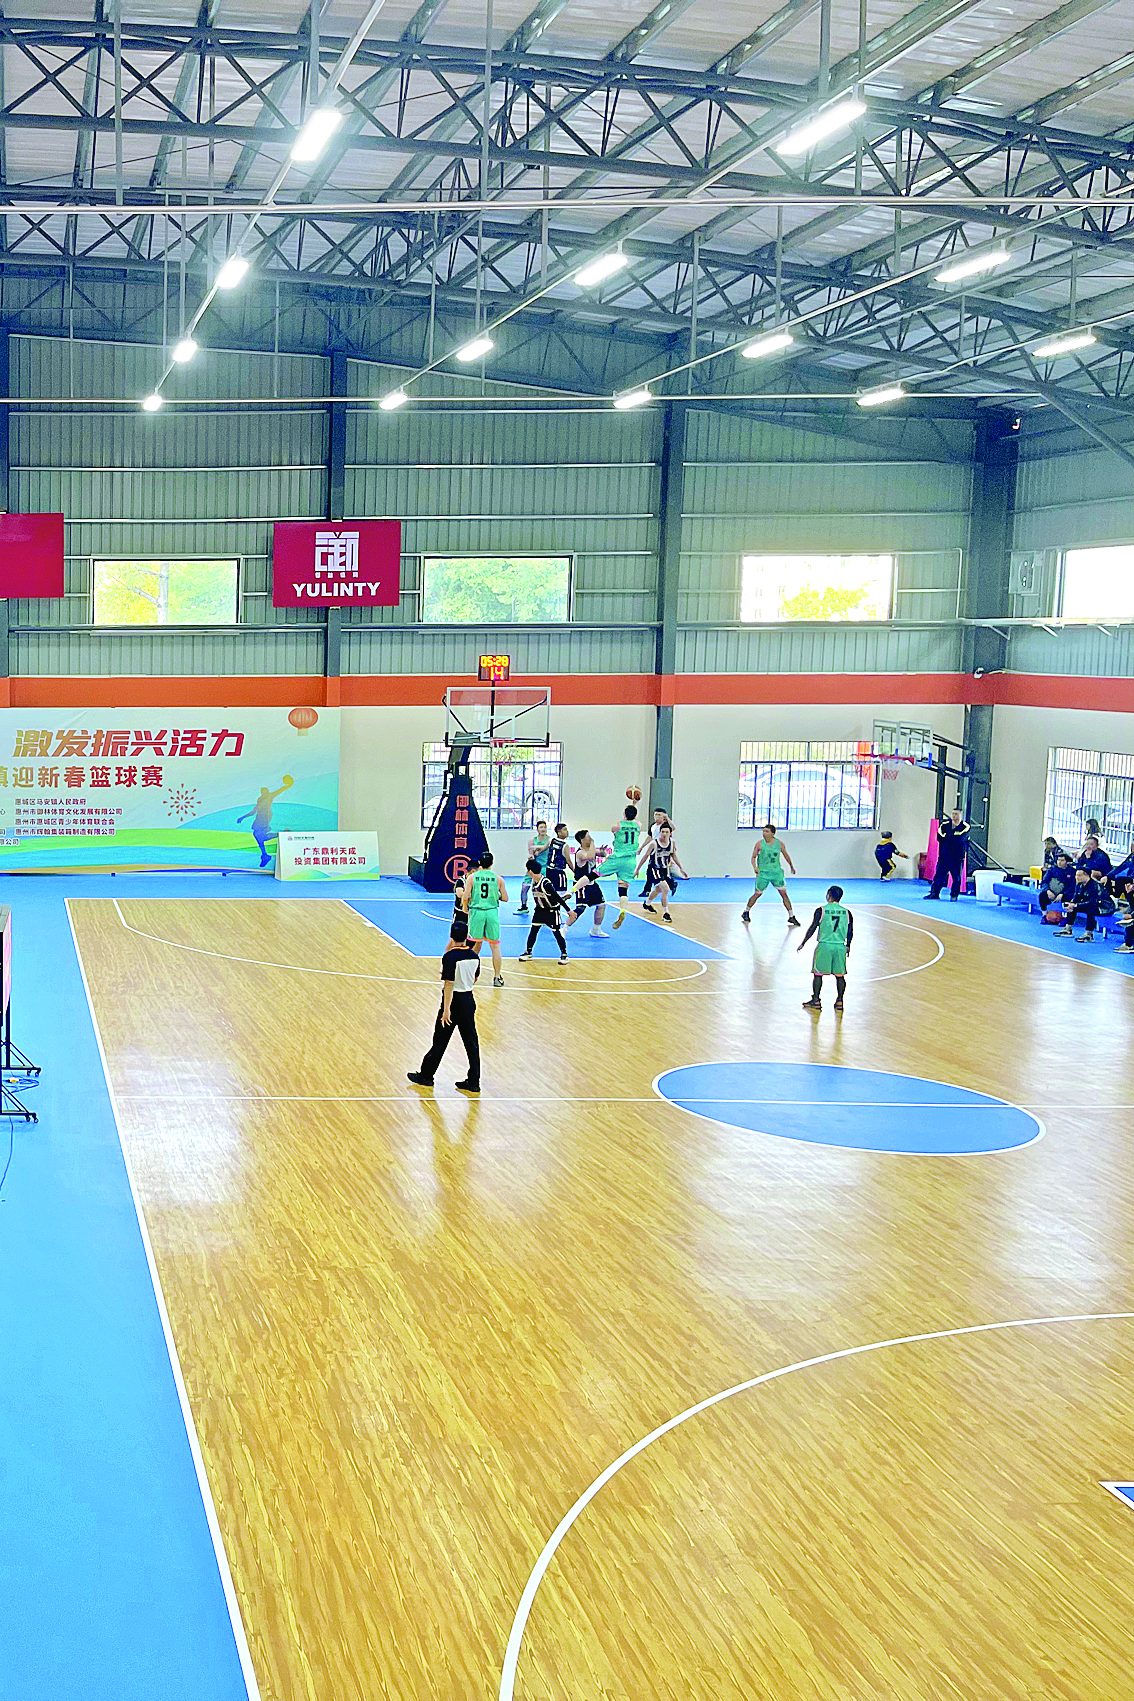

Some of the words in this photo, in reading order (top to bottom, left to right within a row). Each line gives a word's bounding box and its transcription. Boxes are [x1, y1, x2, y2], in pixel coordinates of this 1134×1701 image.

[292, 581, 381, 598] YULINTY
[480, 656, 509, 667] 05:28
[490, 667, 504, 680] 14
[12, 729, 245, 758] 激发振兴活力
[623, 831, 635, 845] 11
[303, 847, 357, 856] 广东鼎利天成
[294, 856, 366, 866] 投资集团有限公司
[452, 859, 469, 880] B
[480, 882, 489, 899] 9
[831, 915, 841, 933] 7
